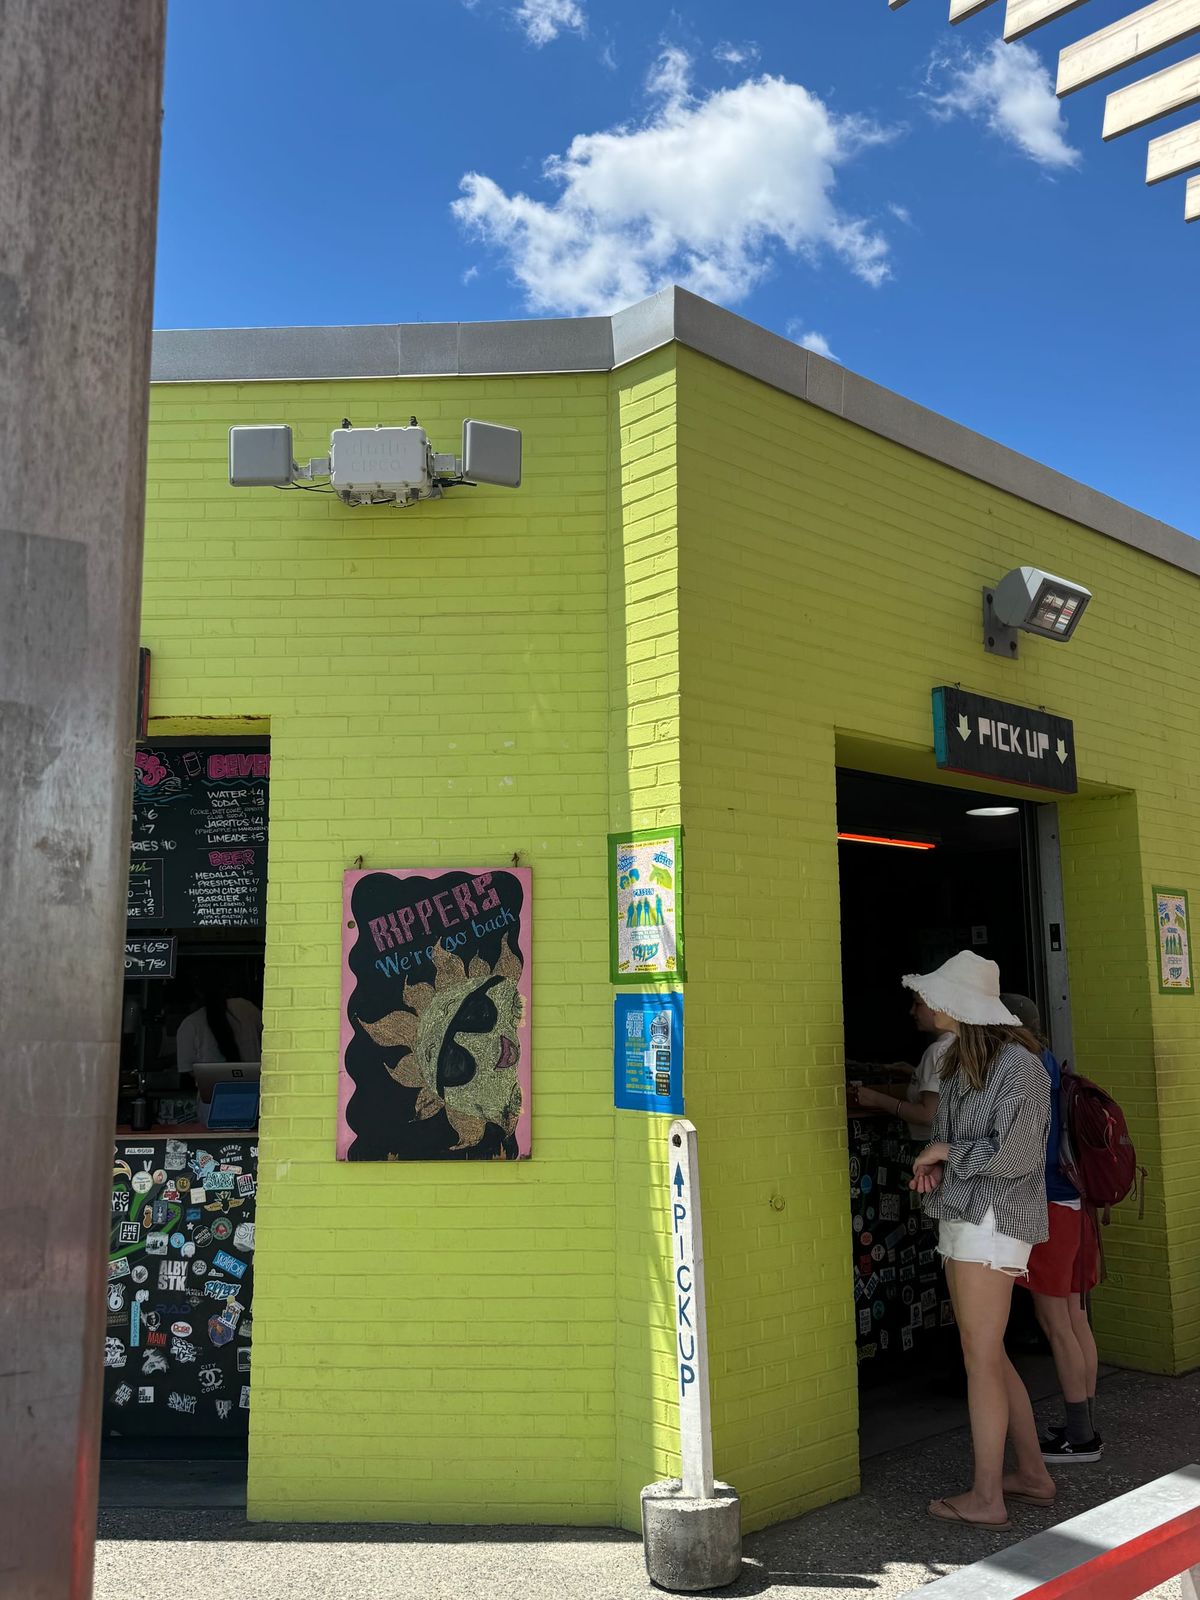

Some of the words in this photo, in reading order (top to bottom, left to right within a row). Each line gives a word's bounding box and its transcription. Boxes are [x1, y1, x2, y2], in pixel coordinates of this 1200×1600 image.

[351, 460, 401, 472] CISCO
[977, 716, 1024, 755] PICK
[1025, 728, 1050, 759] UP
[207, 753, 271, 780] BEVE
[207, 790, 248, 800] WATER
[211, 799, 240, 808] SODA
[142, 807, 159, 820] $6
[204, 818, 250, 829] JARRITOS
[140, 824, 156, 834] $7
[207, 833, 248, 843] LIMEADE
[251, 832, 265, 842] $5
[161, 840, 177, 850] $10
[208, 849, 255, 867] BEER
[195, 871, 240, 880] MEDALLA
[197, 878, 251, 888] PRESIDENTE
[189, 888, 221, 896] HUDSON
[221, 886, 249, 895] CIDER
[197, 895, 240, 903] BARRIER
[197, 907, 233, 916] ATHLETIC
[234, 906, 248, 915] N/A
[368, 872, 501, 952] RIPPERS
[199, 918, 232, 926] AMALFI
[375, 944, 434, 979] We're
[446, 929, 467, 951] so
[471, 907, 516, 937] back
[220, 1144, 242, 1154] FRIENDS
[113, 1192, 129, 1202] NG
[122, 1232, 137, 1240] FIT
[159, 1260, 189, 1276] ALBY
[157, 1275, 187, 1291] STK
